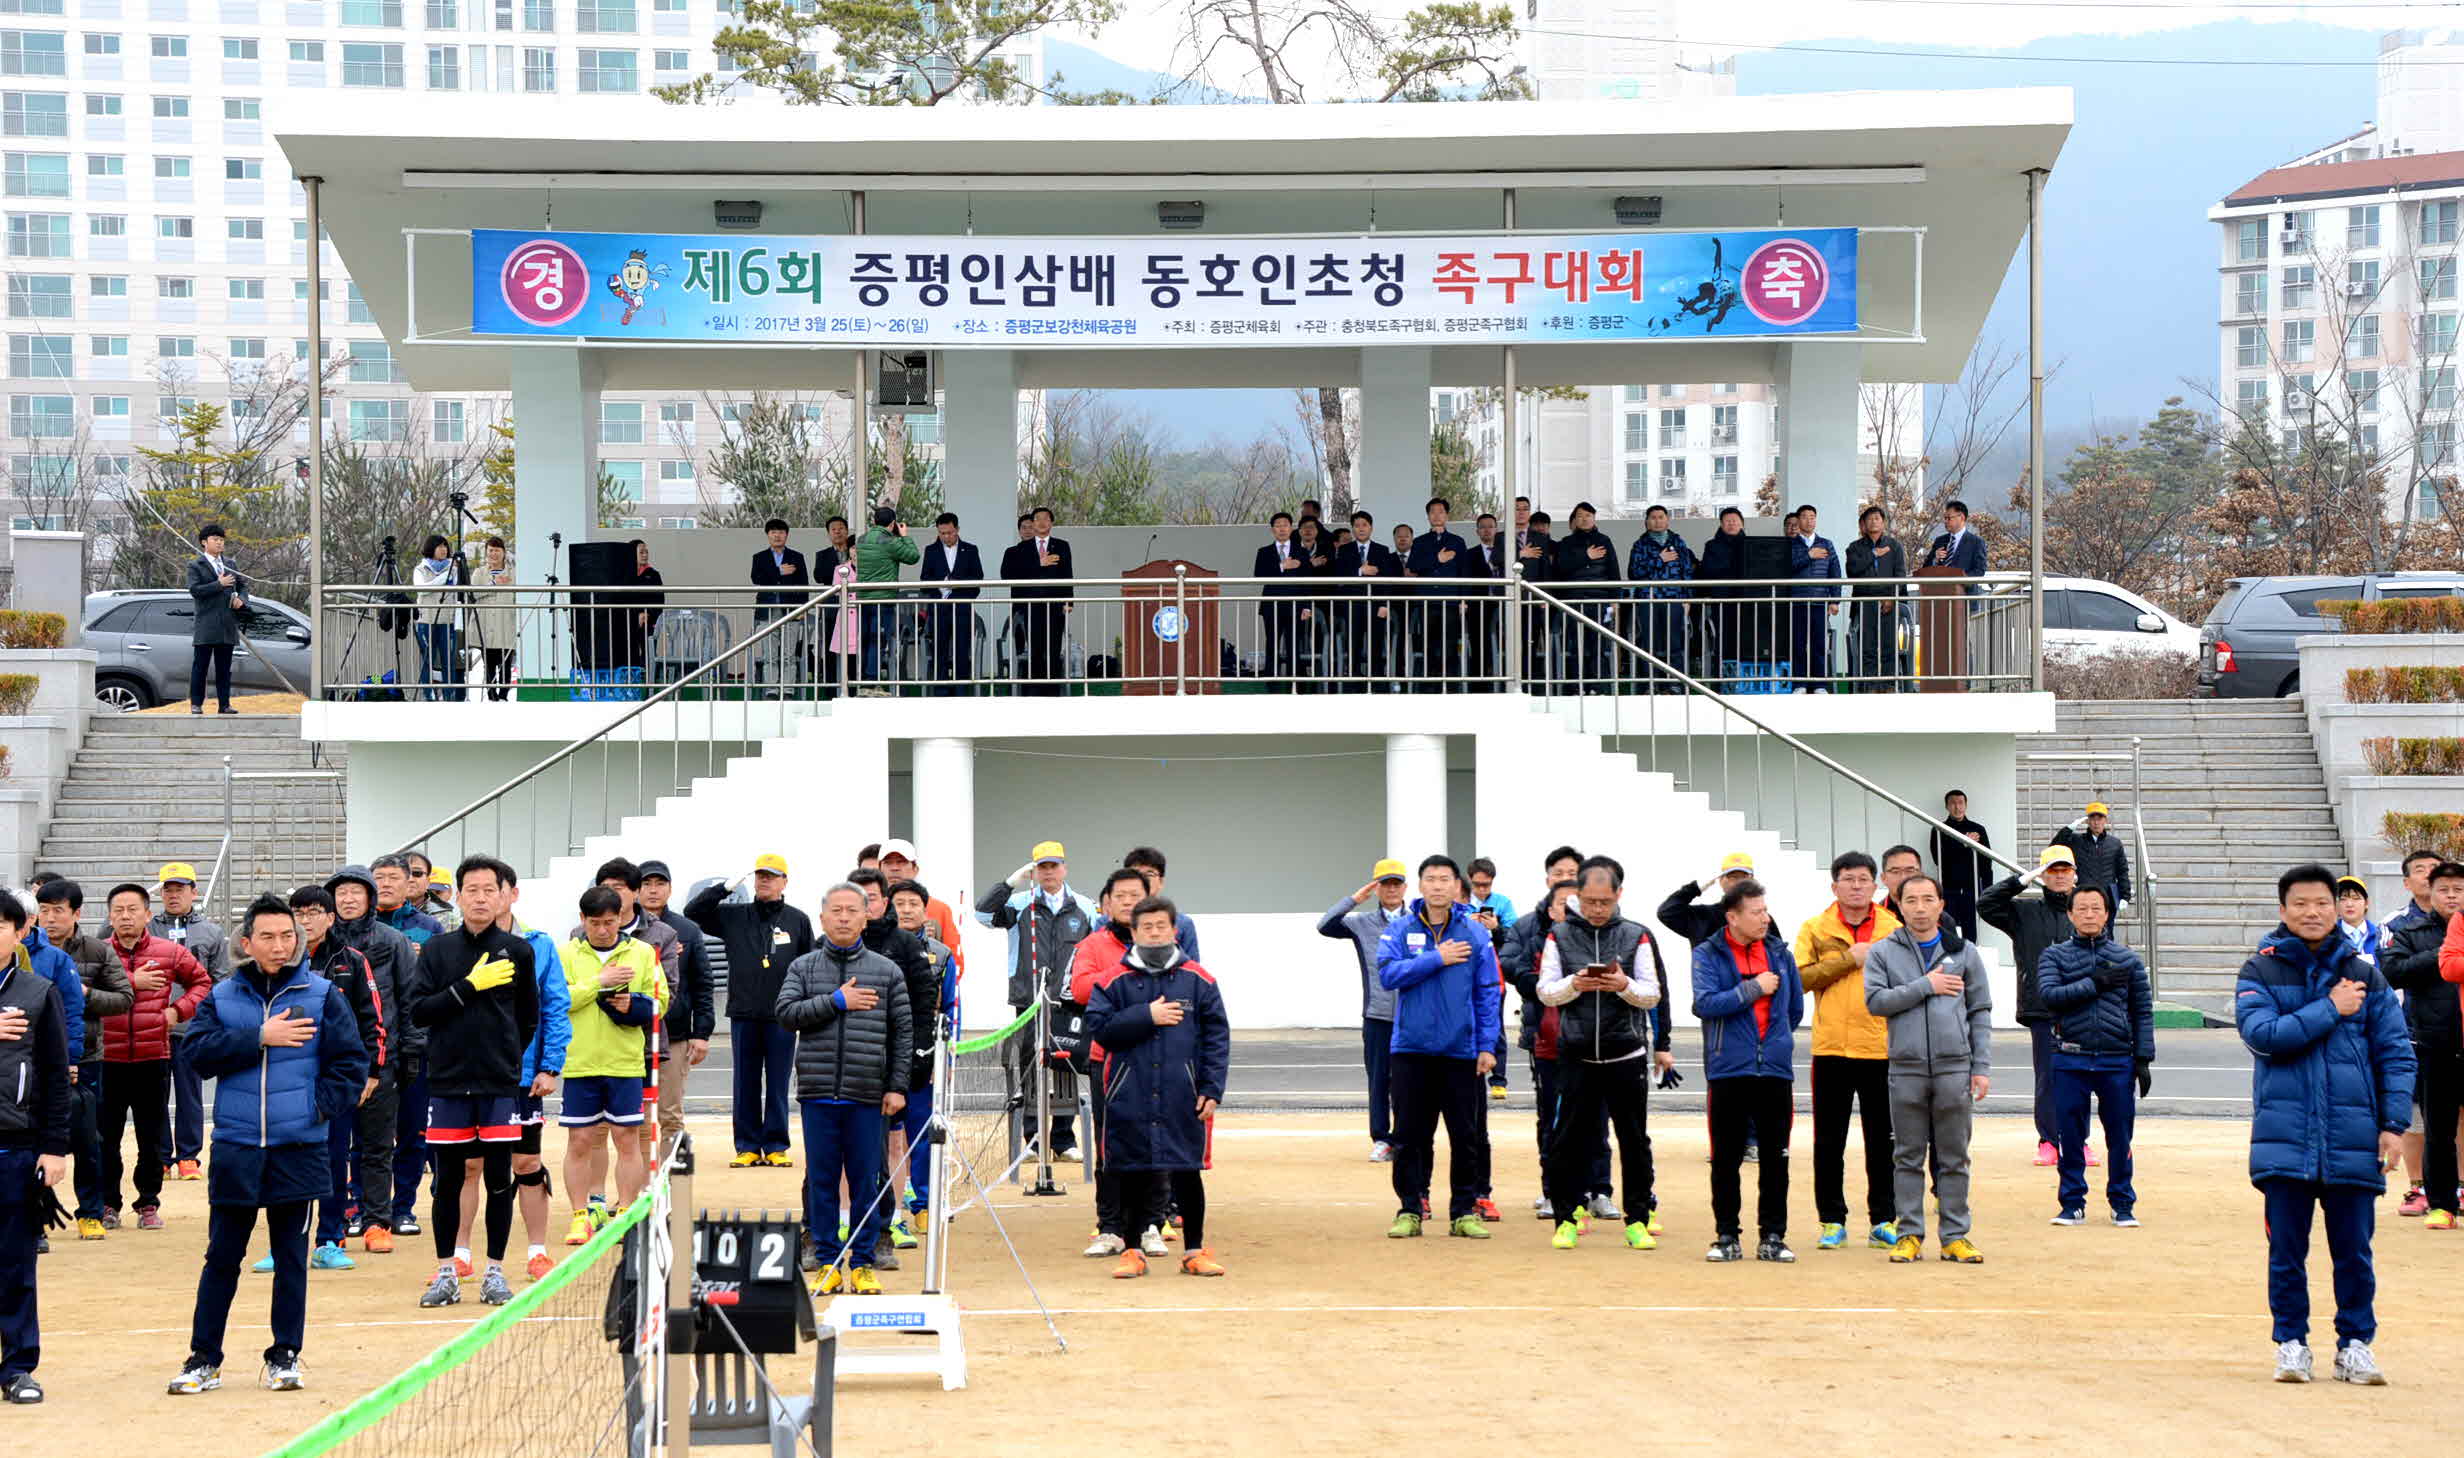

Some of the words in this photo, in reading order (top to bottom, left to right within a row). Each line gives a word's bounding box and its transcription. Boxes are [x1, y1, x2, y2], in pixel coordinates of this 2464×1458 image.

[522, 259, 566, 312] 경
[683, 248, 822, 305] 제6회
[849, 253, 1115, 307] 증평인삼배
[1142, 253, 1404, 307] 동호인초청
[1432, 250, 1643, 304] 족구대회
[1760, 257, 1807, 309] 축
[711, 315, 739, 331] 일시
[753, 316, 801, 332] 2017년
[804, 317, 827, 333] 3월
[962, 318, 989, 335] 장소
[1004, 318, 1138, 335] 증평군보강천체육공원
[1171, 318, 1196, 334] 주최
[1209, 318, 1282, 335] 증평군체육회
[1303, 318, 1328, 334] 주관
[1443, 316, 1528, 333] 증평군족구협회
[1549, 314, 1575, 331] 후원
[1588, 314, 1626, 331] 증평군
[1071, 1016, 1082, 1033] 0
[757, 1232, 786, 1279] 2
